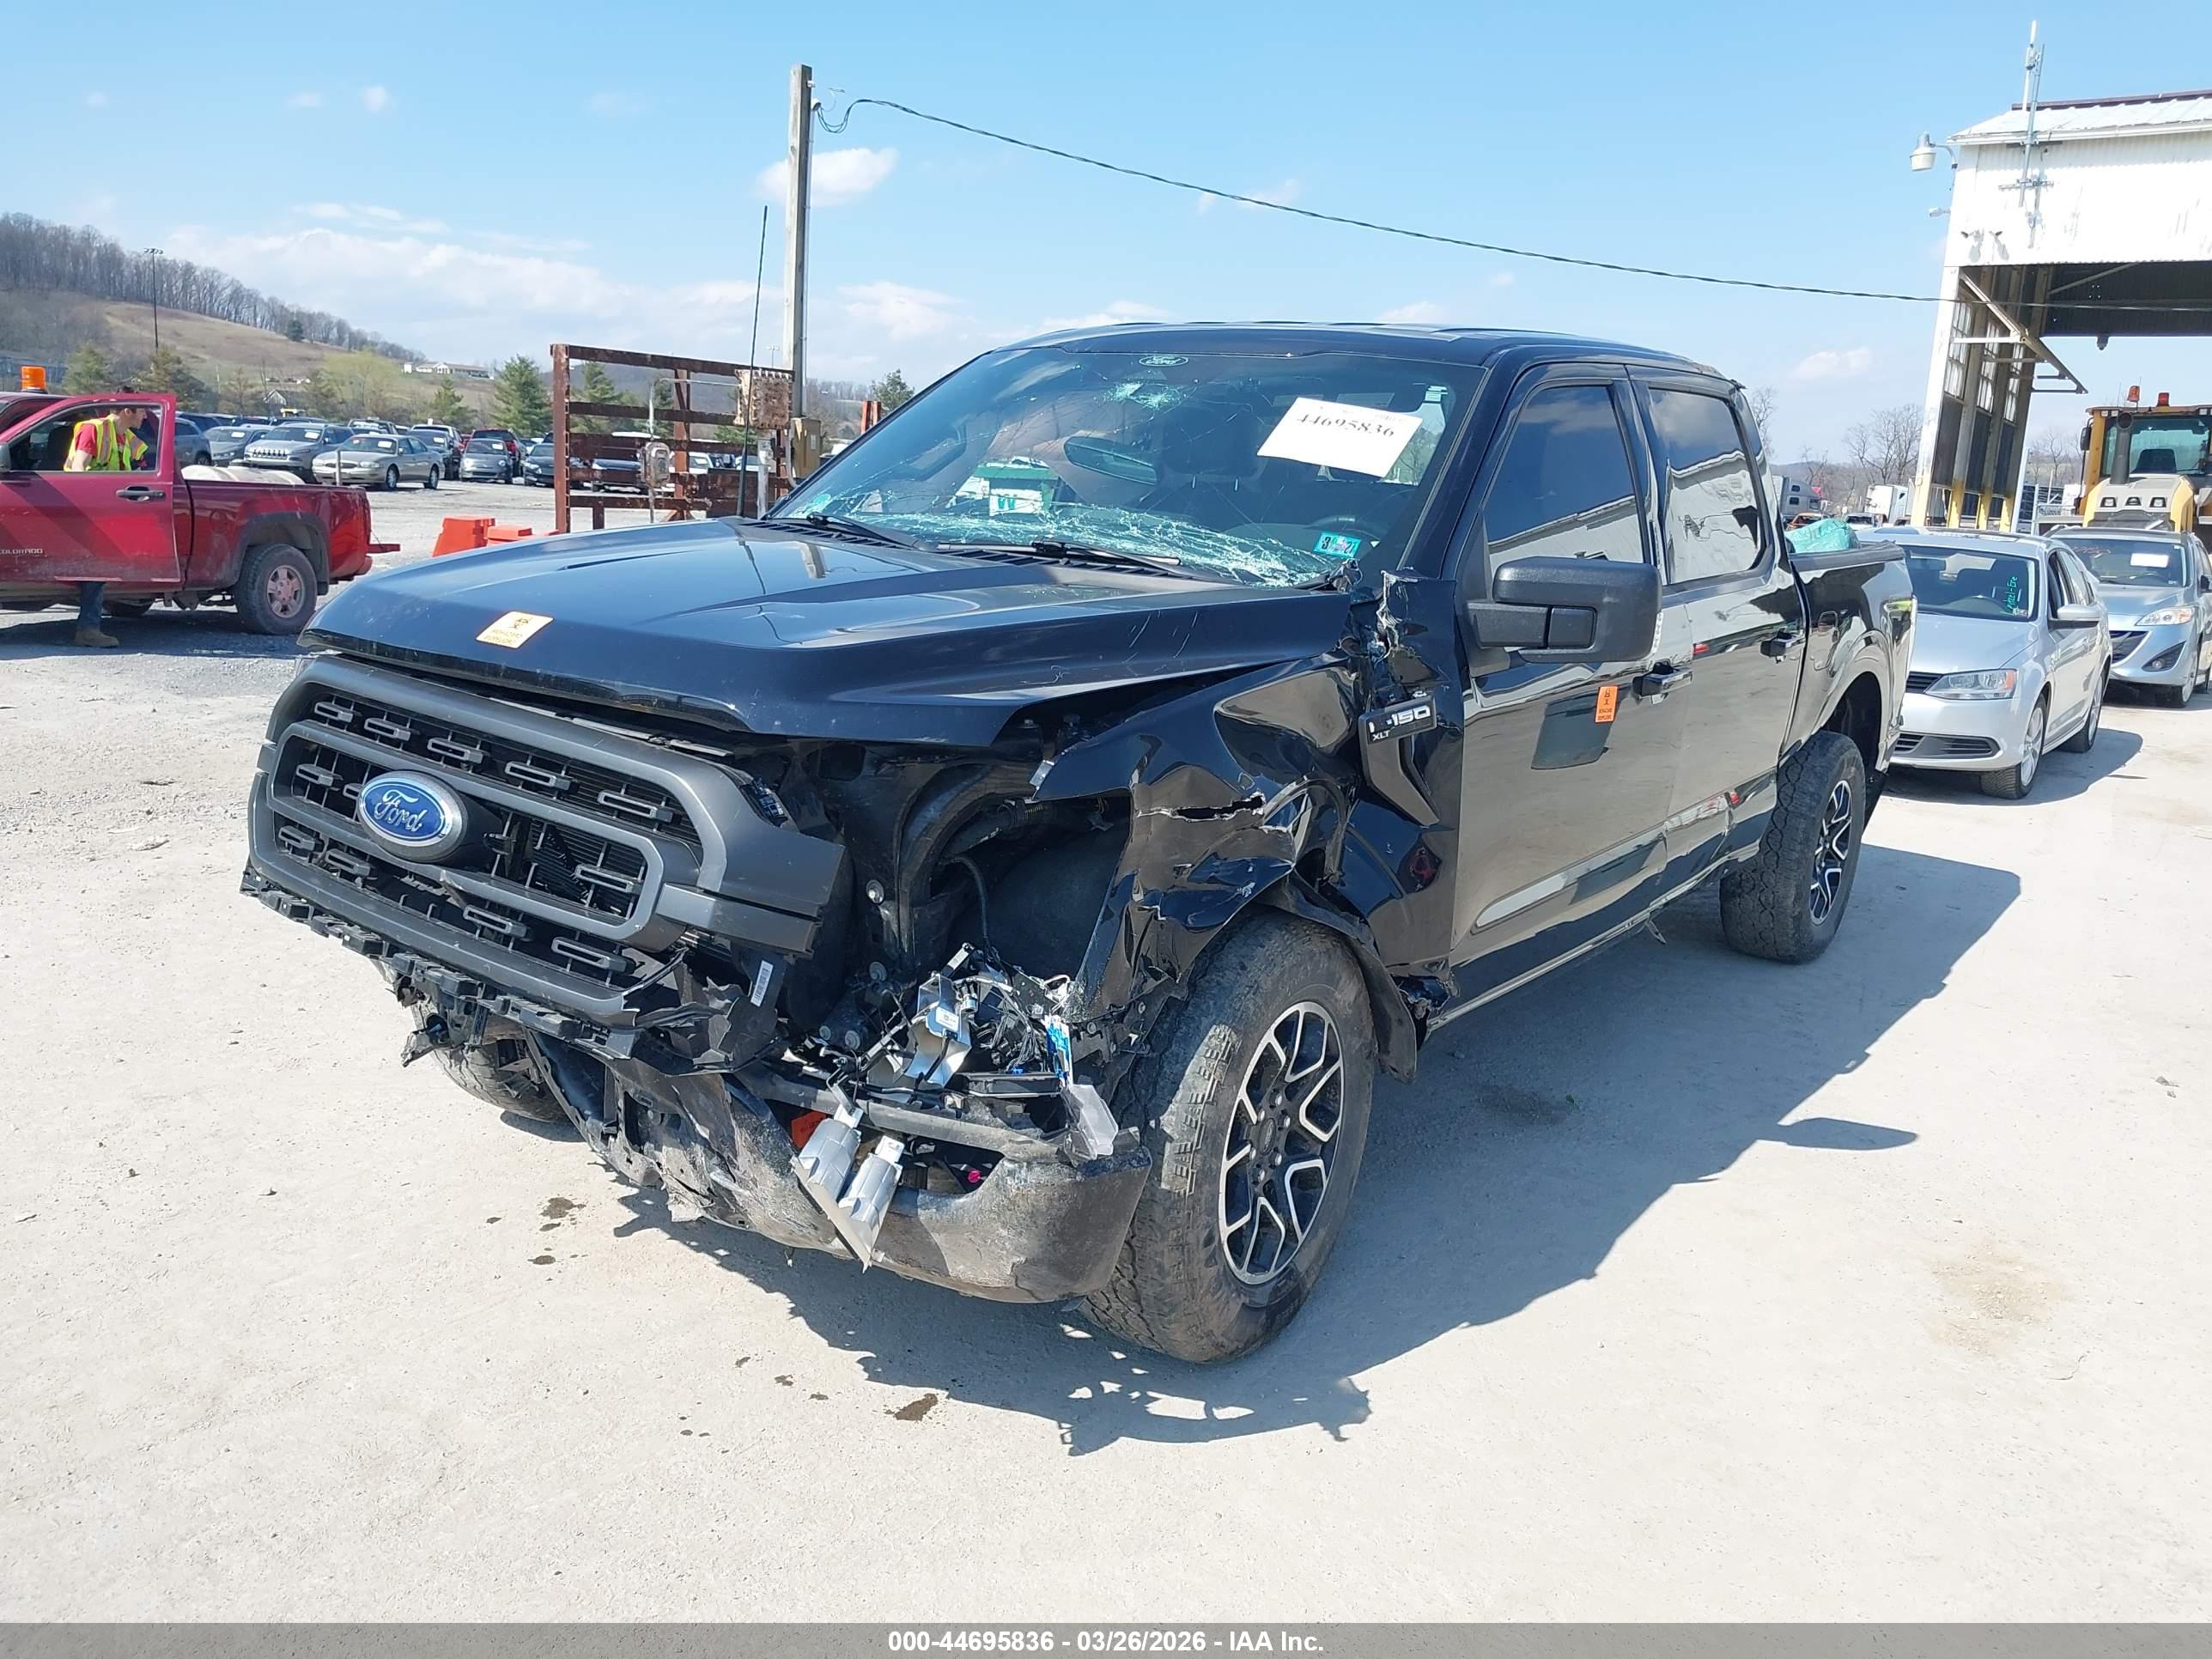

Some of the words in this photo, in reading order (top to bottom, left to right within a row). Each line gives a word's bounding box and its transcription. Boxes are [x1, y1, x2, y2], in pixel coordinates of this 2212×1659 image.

[1297, 413, 1395, 438] 44695836
[1372, 730, 1391, 741] XLT
[374, 789, 428, 832] Ford
